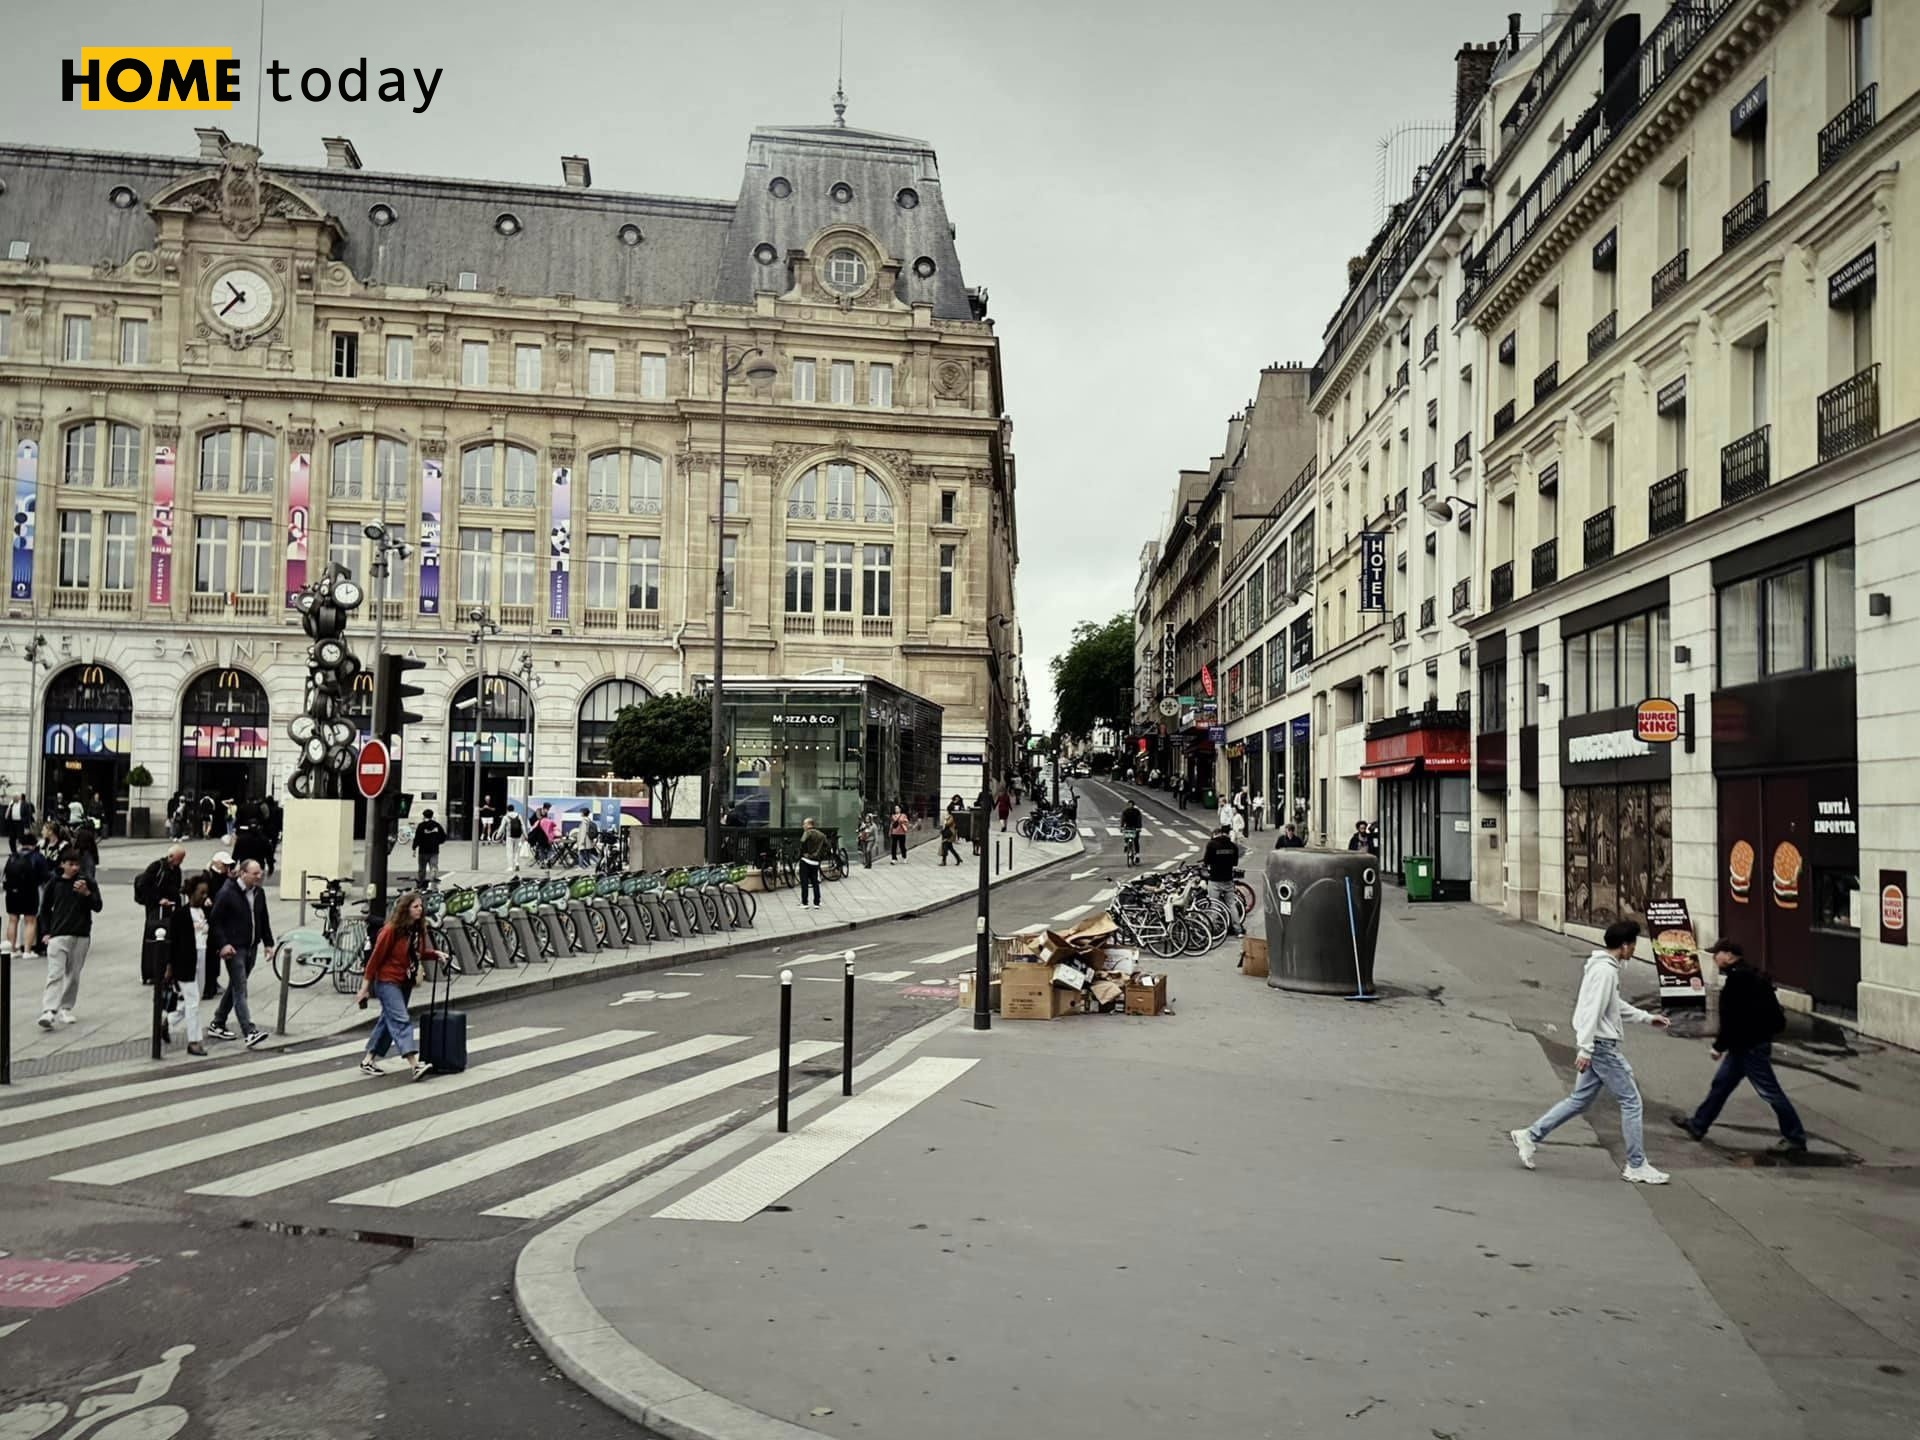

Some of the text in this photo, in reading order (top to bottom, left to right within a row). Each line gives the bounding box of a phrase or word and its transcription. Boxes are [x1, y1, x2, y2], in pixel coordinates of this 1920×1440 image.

[1371, 540, 1383, 608] HOTEL
[153, 638, 281, 660] SAINT
[1638, 712, 1676, 721] BURGER
[1638, 721, 1676, 733] KING
[1818, 801, 1843, 814] VENTE
[1814, 820, 1856, 834] EMPORTER
[1884, 908, 1902, 919] KING
